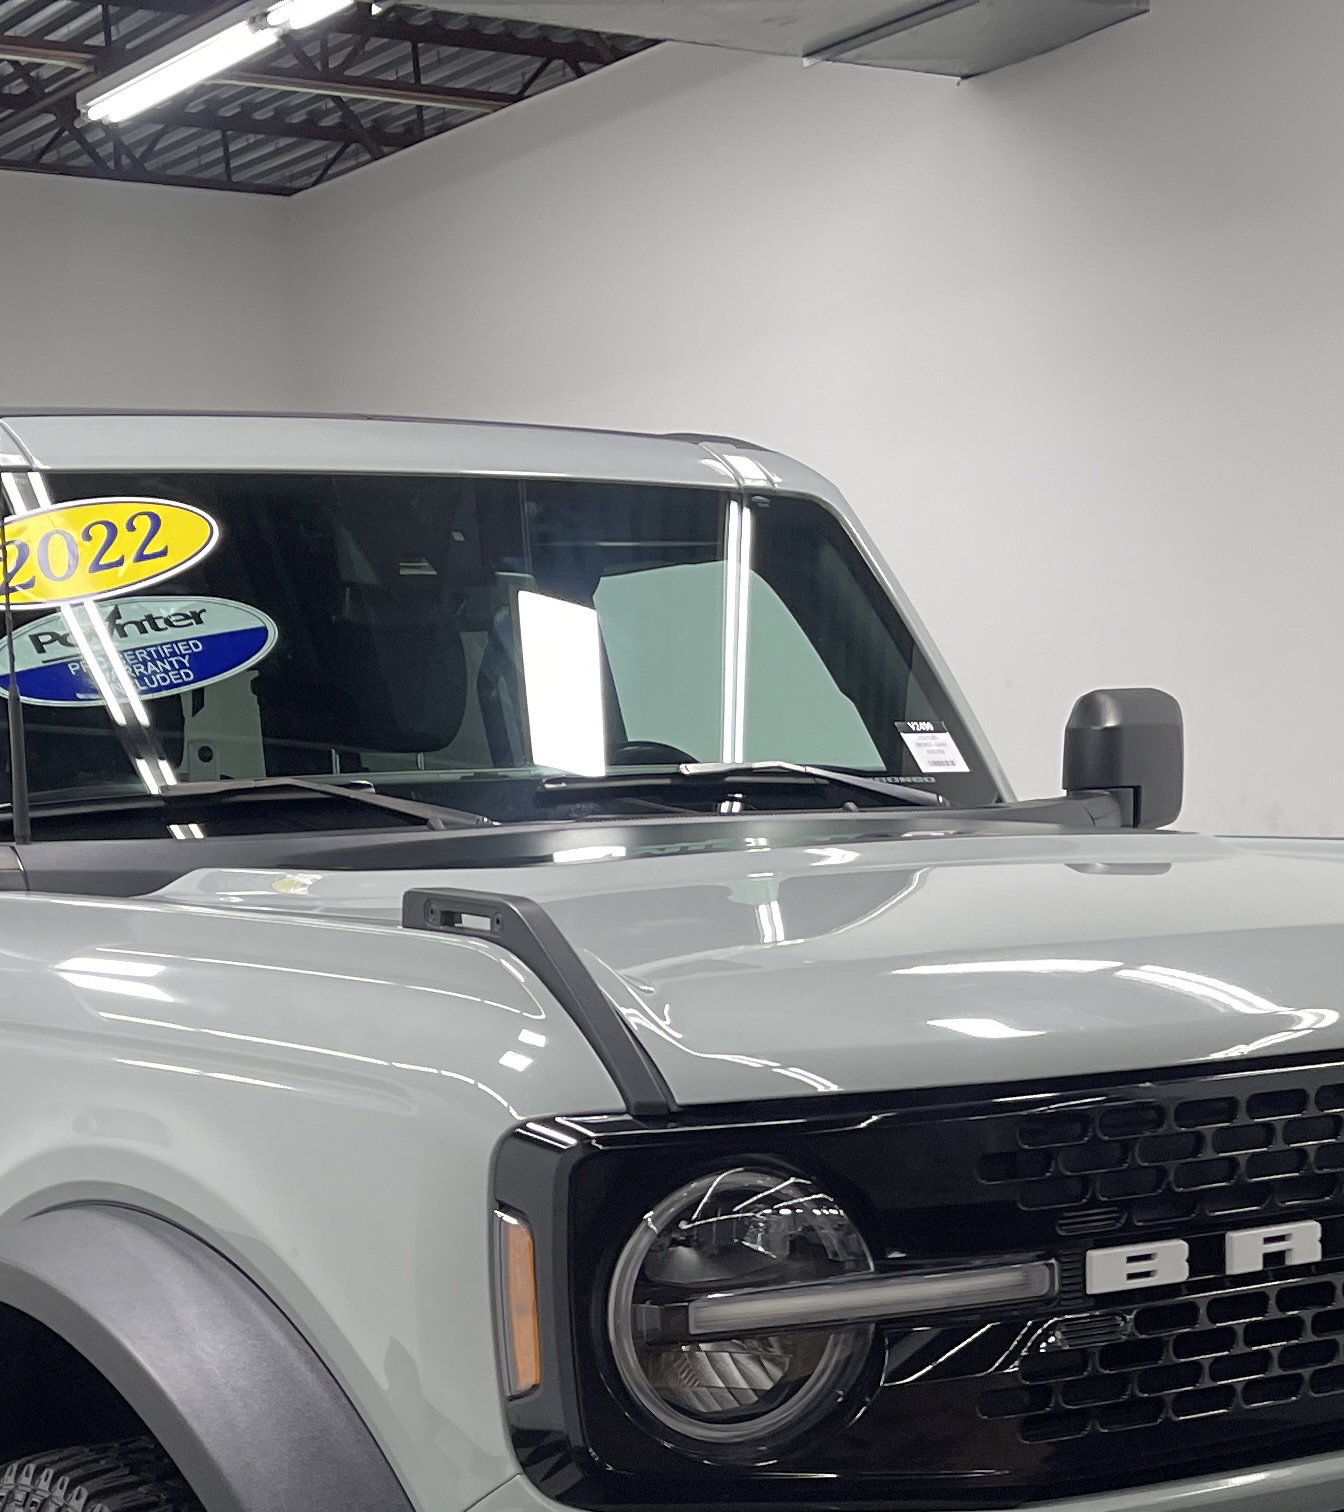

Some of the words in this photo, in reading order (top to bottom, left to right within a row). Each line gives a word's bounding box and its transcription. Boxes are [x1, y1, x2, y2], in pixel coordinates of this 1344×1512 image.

[116, 640, 204, 665] ERTIFIED
[102, 655, 191, 682] WRRANTY
[872, 776, 937, 784] RONCO
